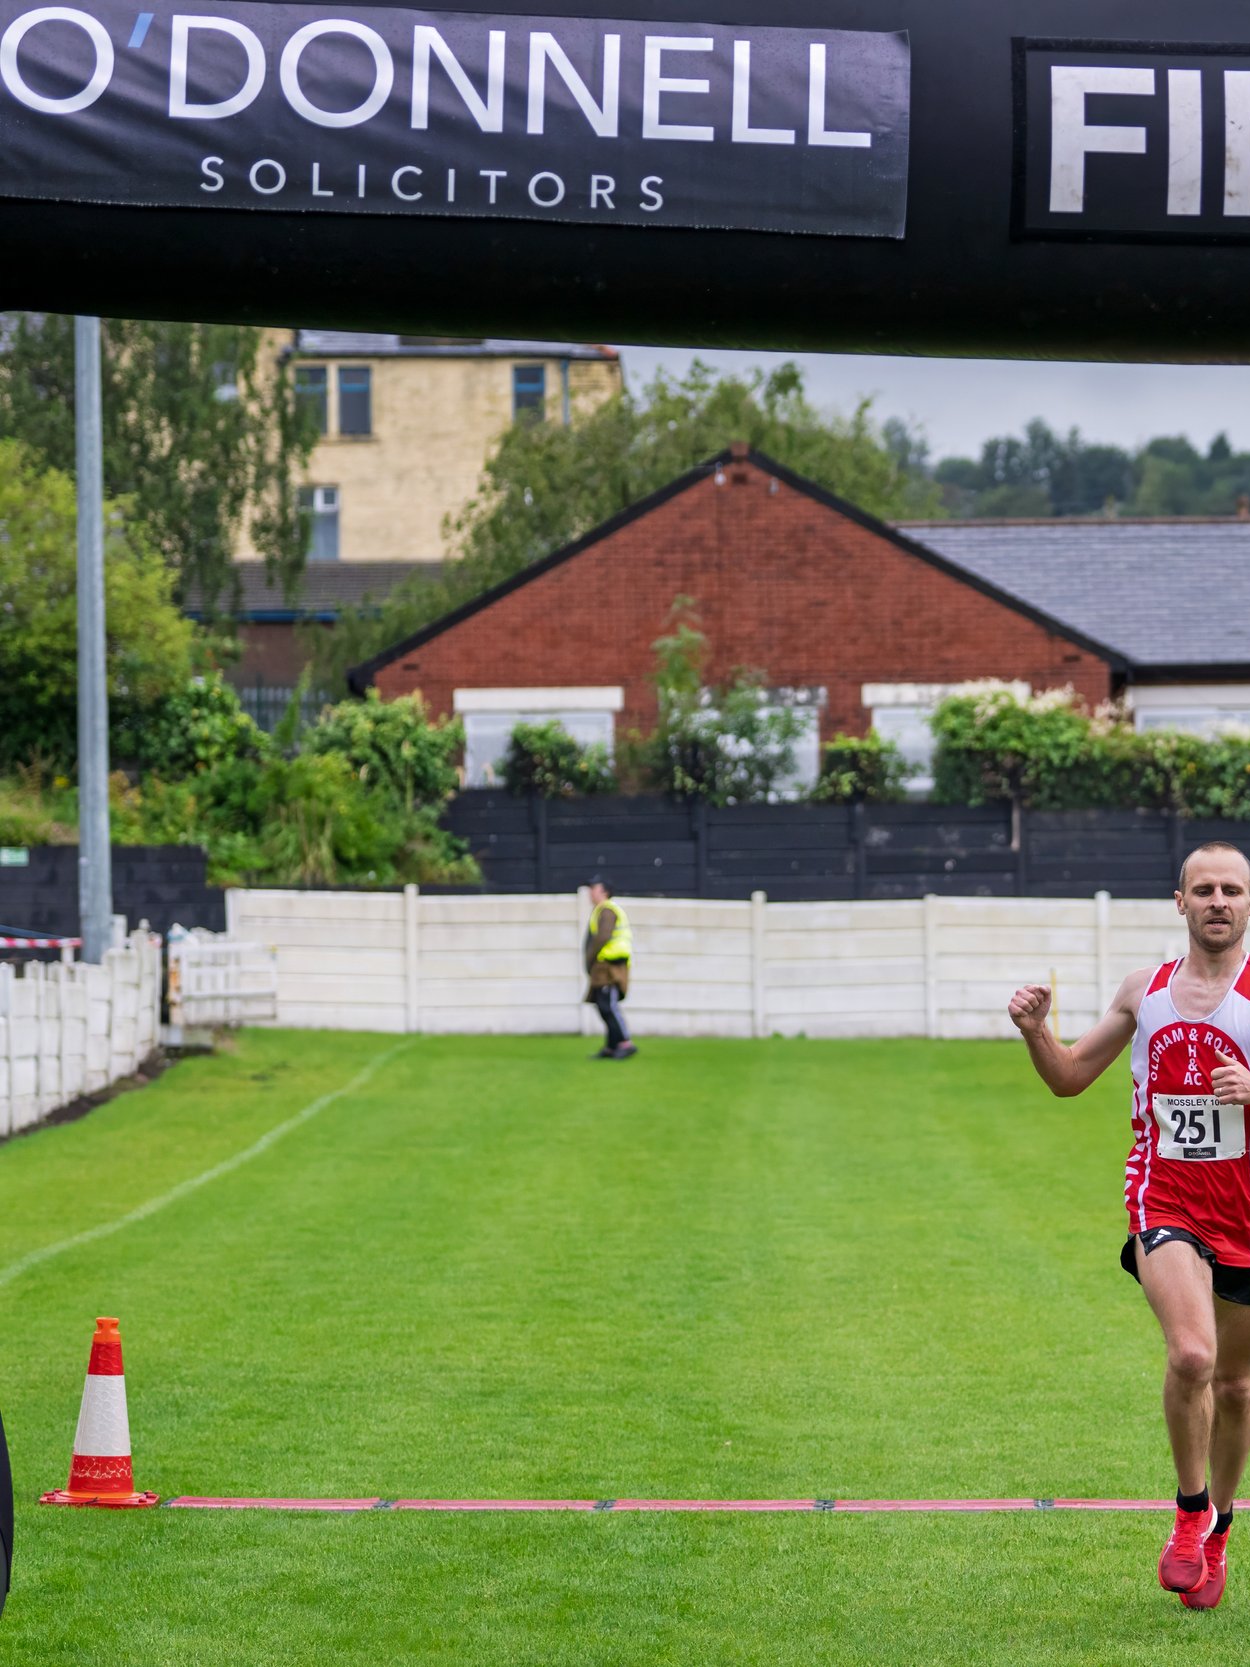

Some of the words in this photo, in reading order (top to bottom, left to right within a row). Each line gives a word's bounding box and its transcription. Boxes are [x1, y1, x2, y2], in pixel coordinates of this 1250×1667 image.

[0, 6, 872, 148] O'DONNELL
[200, 156, 665, 212] SOLICITORS
[1150, 1027, 1185, 1082] OLDHAM
[1188, 1028, 1199, 1042] &
[1187, 1044, 1197, 1058] H
[1188, 1058, 1198, 1072] &
[1183, 1071, 1203, 1086] AC
[1167, 1098, 1208, 1107] MOSSLEY
[1170, 1109, 1221, 1145] 251
